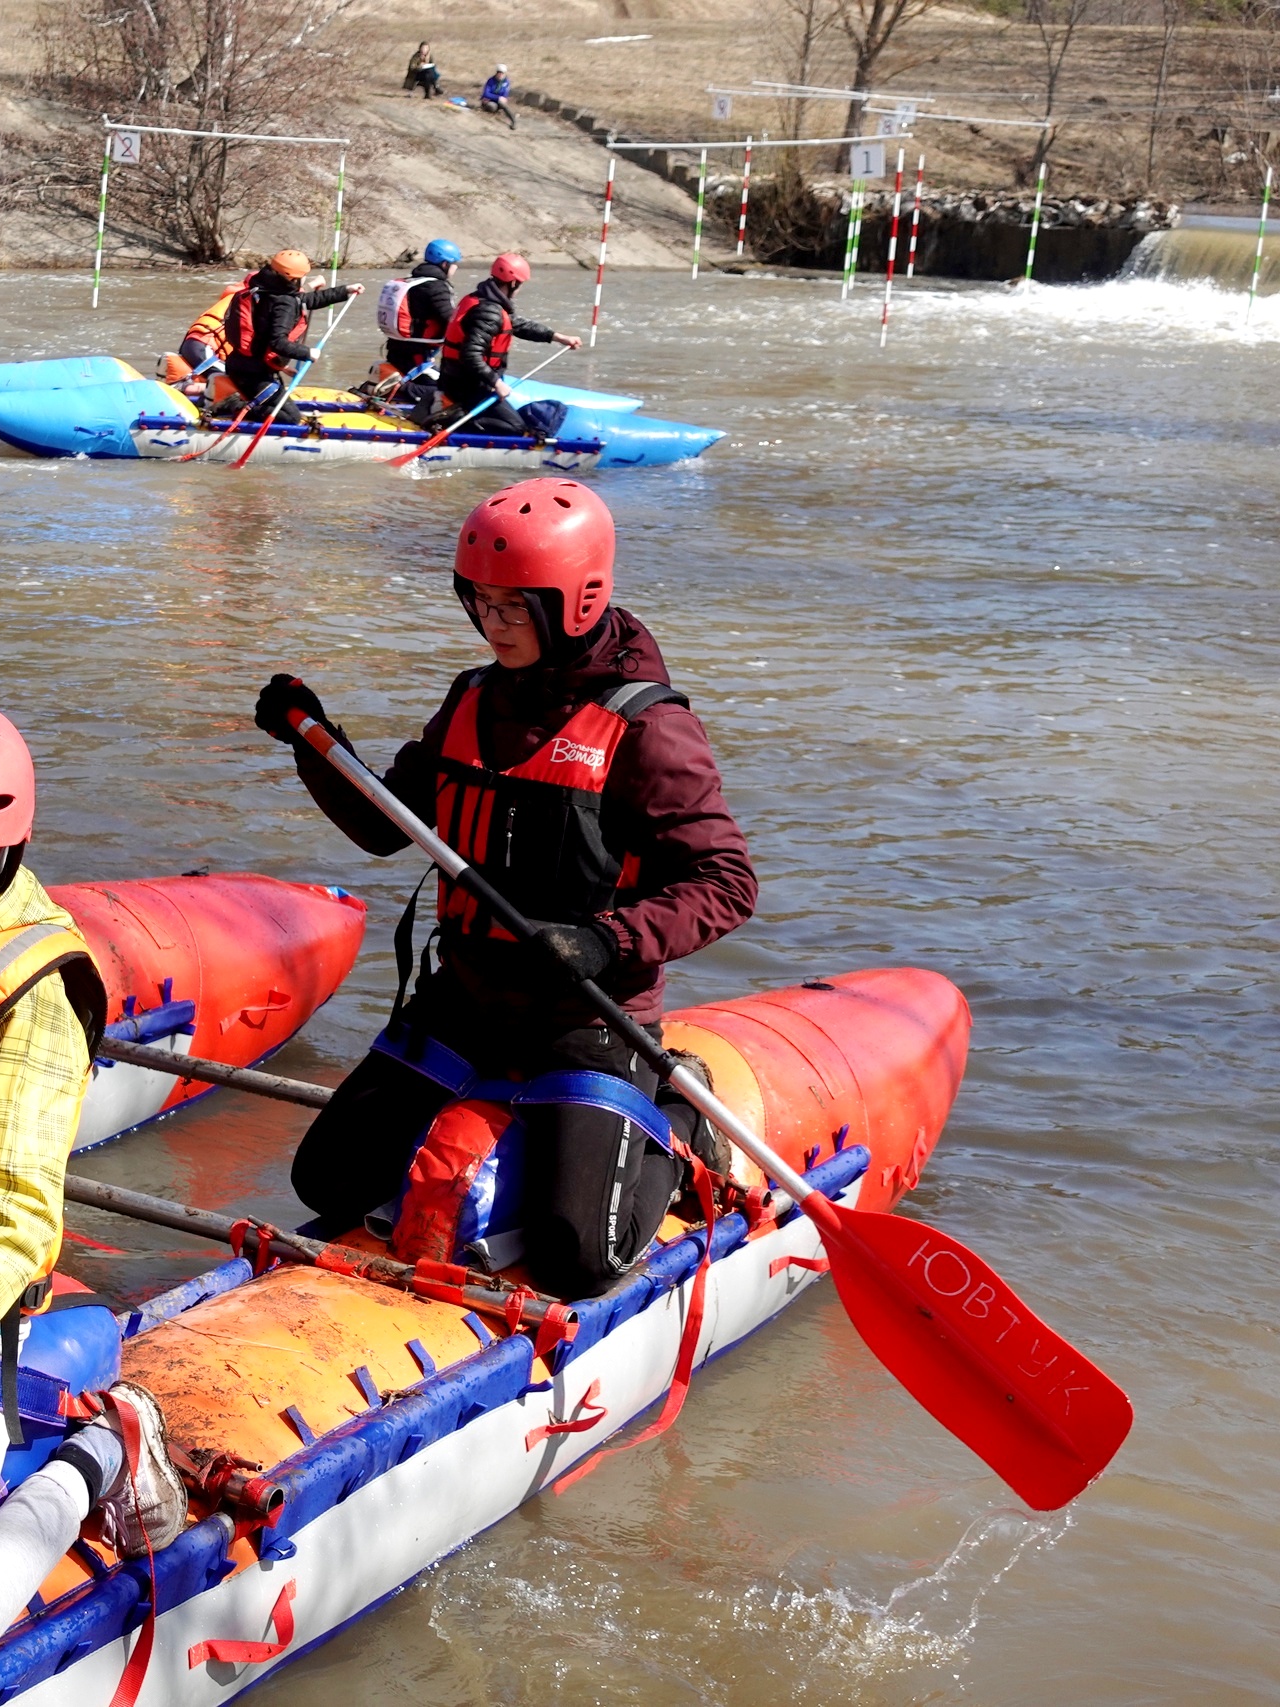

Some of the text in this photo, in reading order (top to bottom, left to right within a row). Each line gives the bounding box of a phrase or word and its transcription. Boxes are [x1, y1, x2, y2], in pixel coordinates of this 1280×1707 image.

[121, 136, 134, 158] 2
[863, 150, 873, 174] 1
[608, 1214, 617, 1242] SPORT
